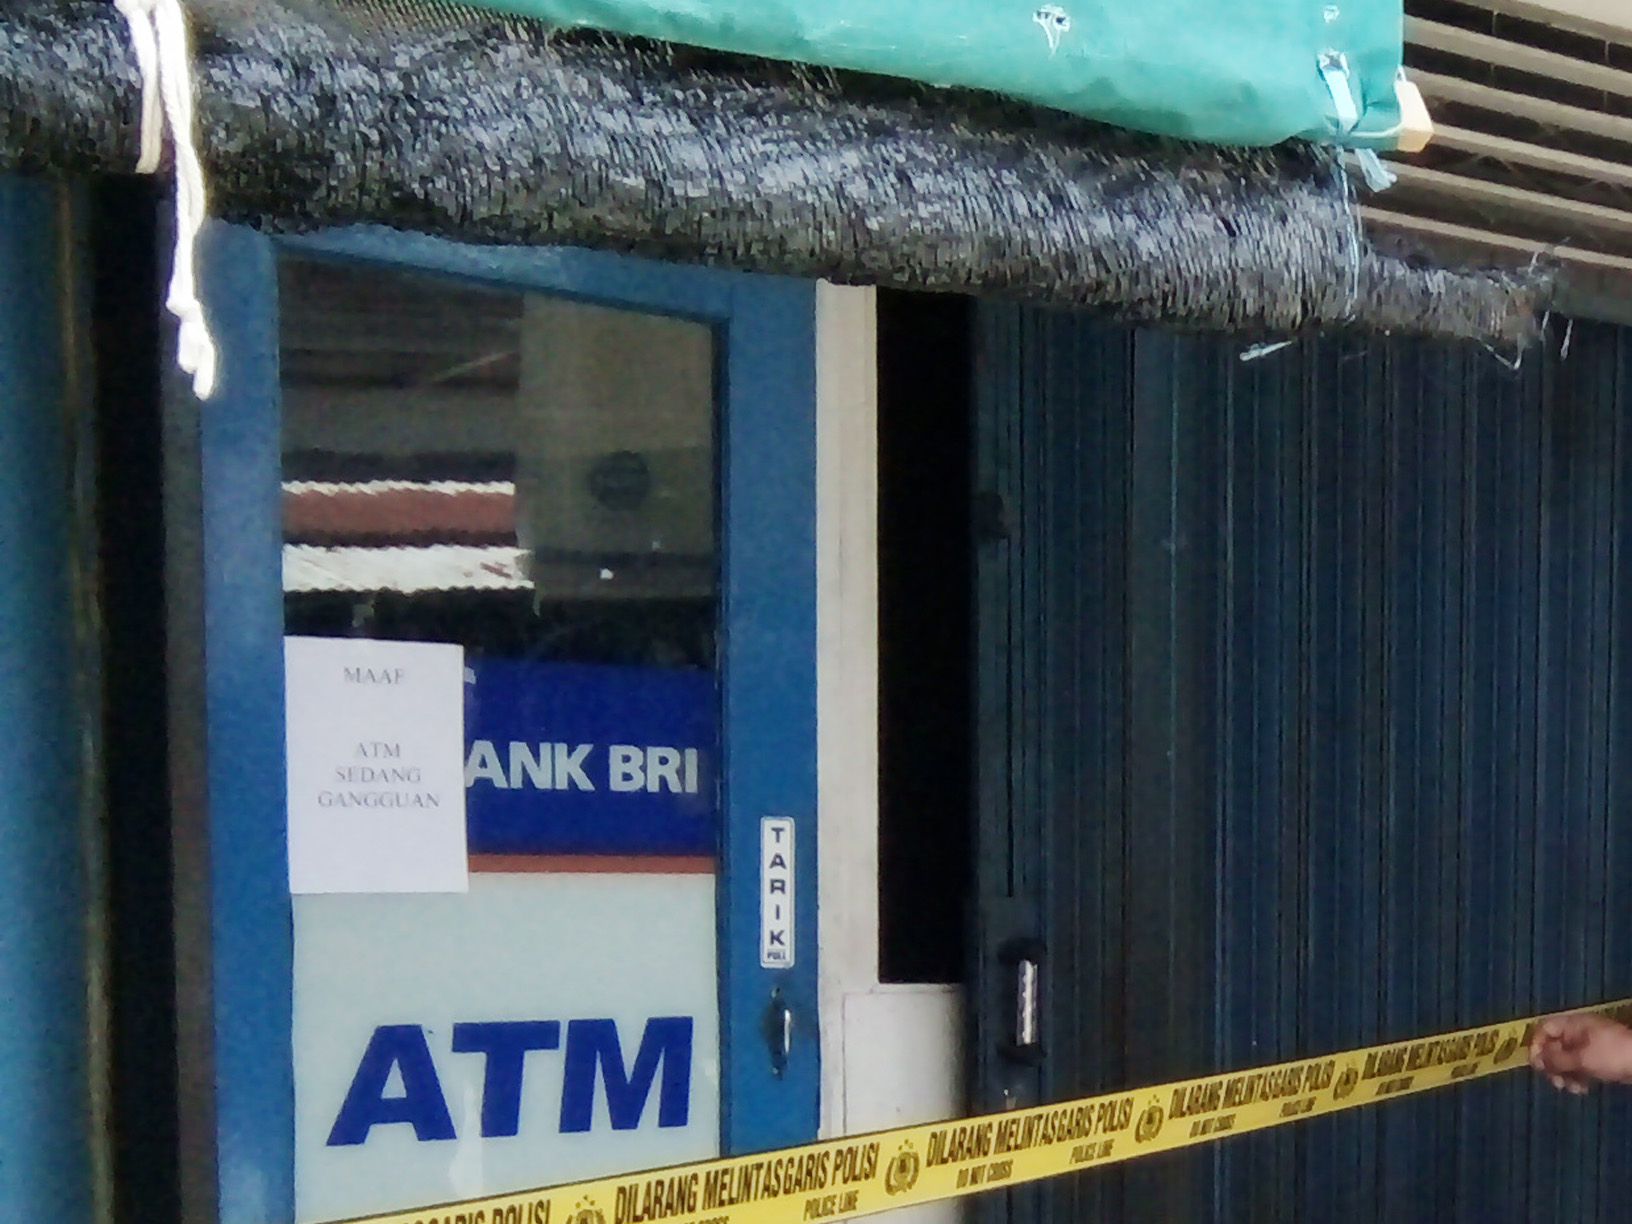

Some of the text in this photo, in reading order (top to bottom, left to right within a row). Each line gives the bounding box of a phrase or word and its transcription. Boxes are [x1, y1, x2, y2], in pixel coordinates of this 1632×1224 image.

[344, 667, 404, 685] MAAF
[355, 742, 401, 758] ATM
[335, 766, 421, 783] SEDANG
[464, 740, 698, 793] ANK BRI
[318, 790, 440, 808] GANGGUAN
[769, 828, 787, 946] TARIK
[326, 1016, 693, 1146] ATM
[831, 1141, 881, 1186] POLISI
